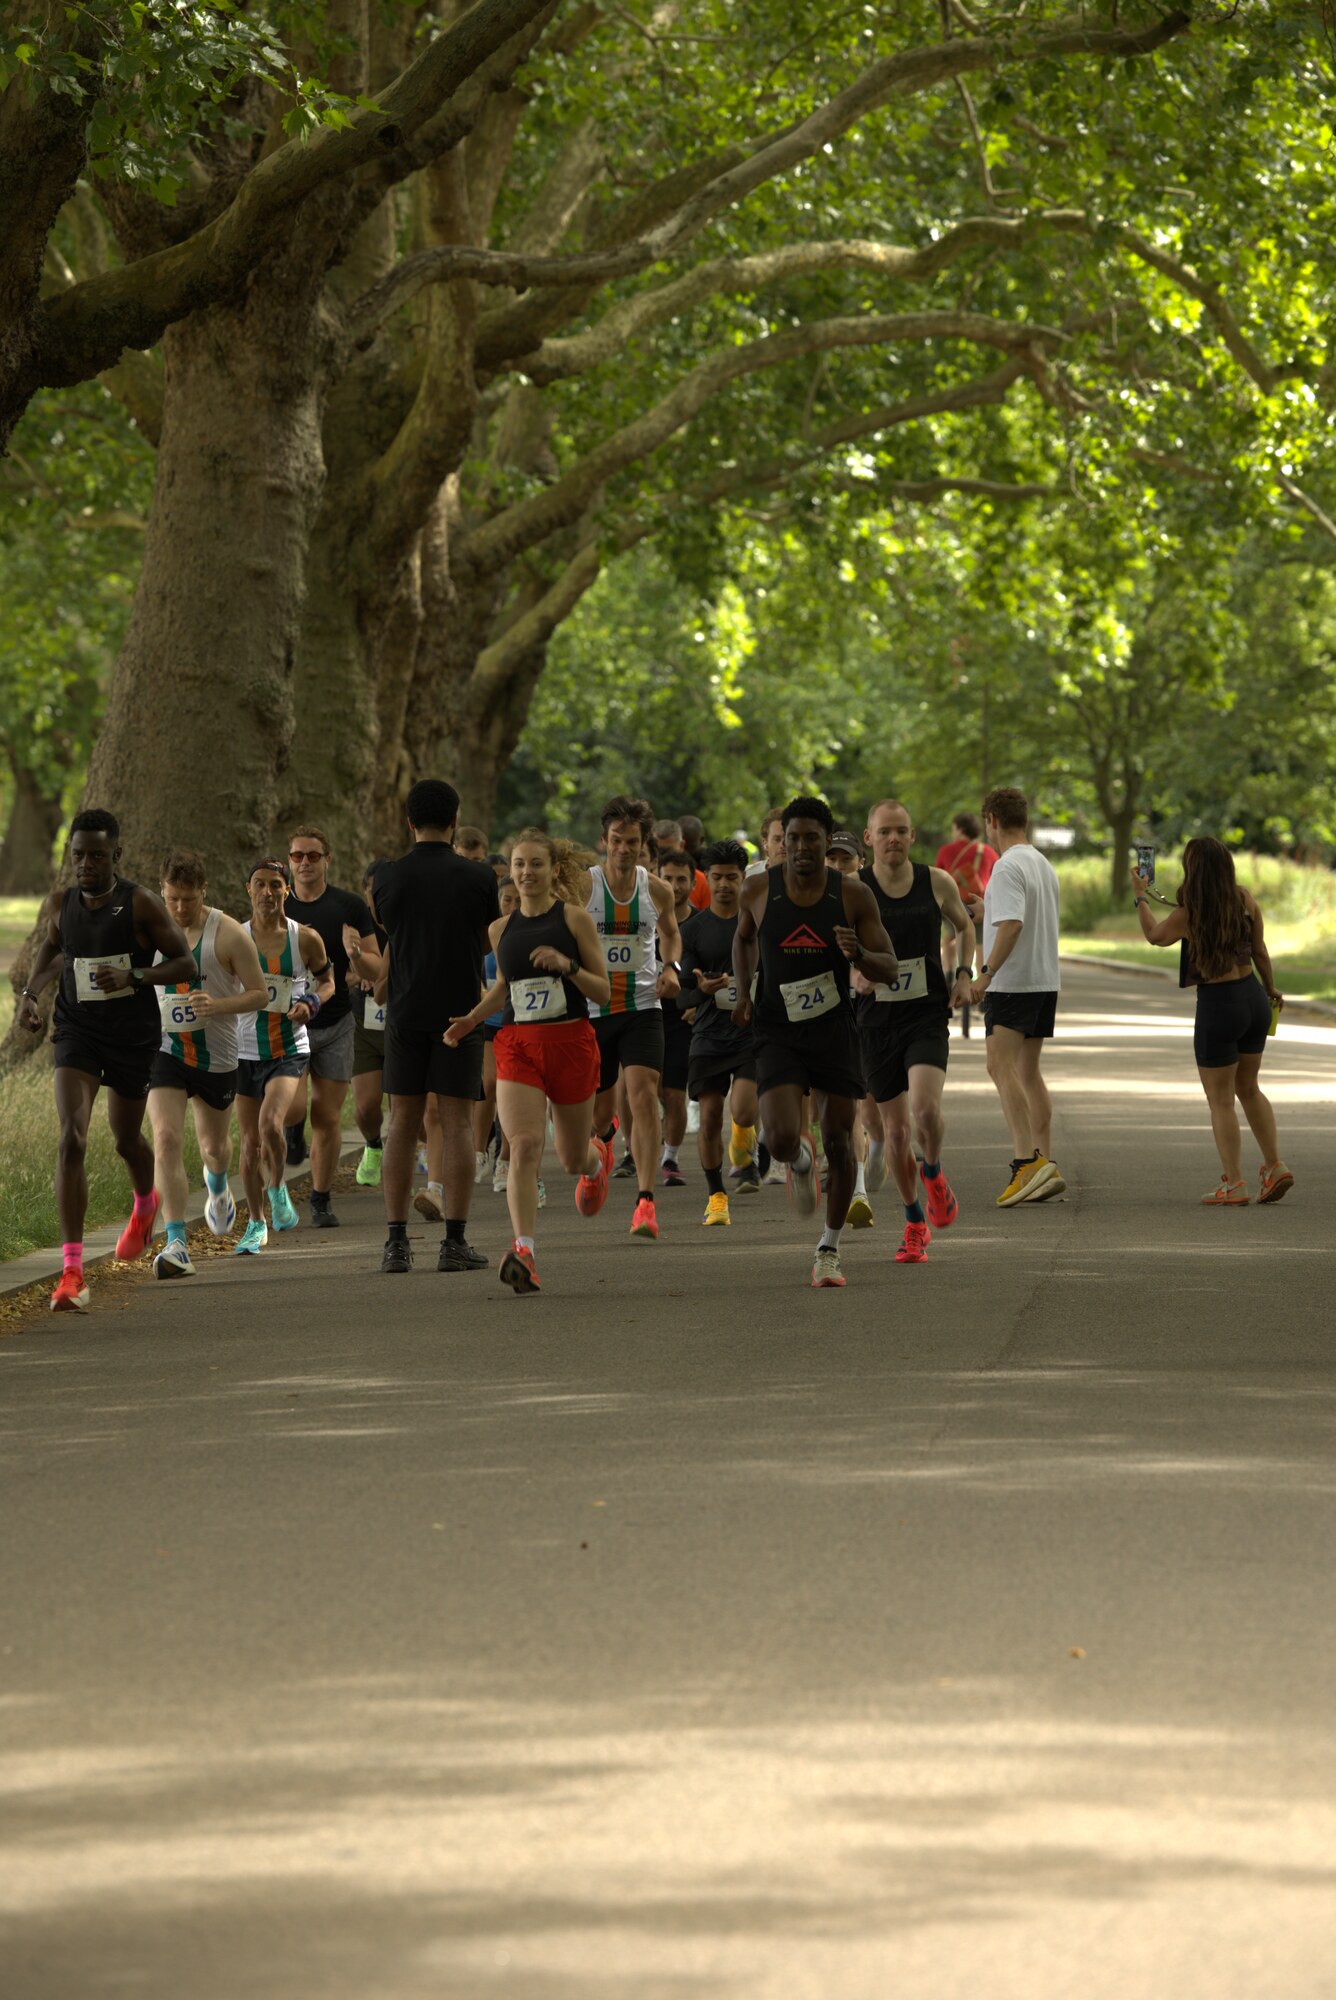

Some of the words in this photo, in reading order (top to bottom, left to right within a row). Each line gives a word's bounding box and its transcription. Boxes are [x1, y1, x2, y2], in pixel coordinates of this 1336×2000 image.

[607, 946, 631, 963] 60
[525, 990, 549, 1010] 27
[798, 987, 824, 1010] 24
[171, 1005, 197, 1023] 65
[375, 1008, 385, 1023] 4
